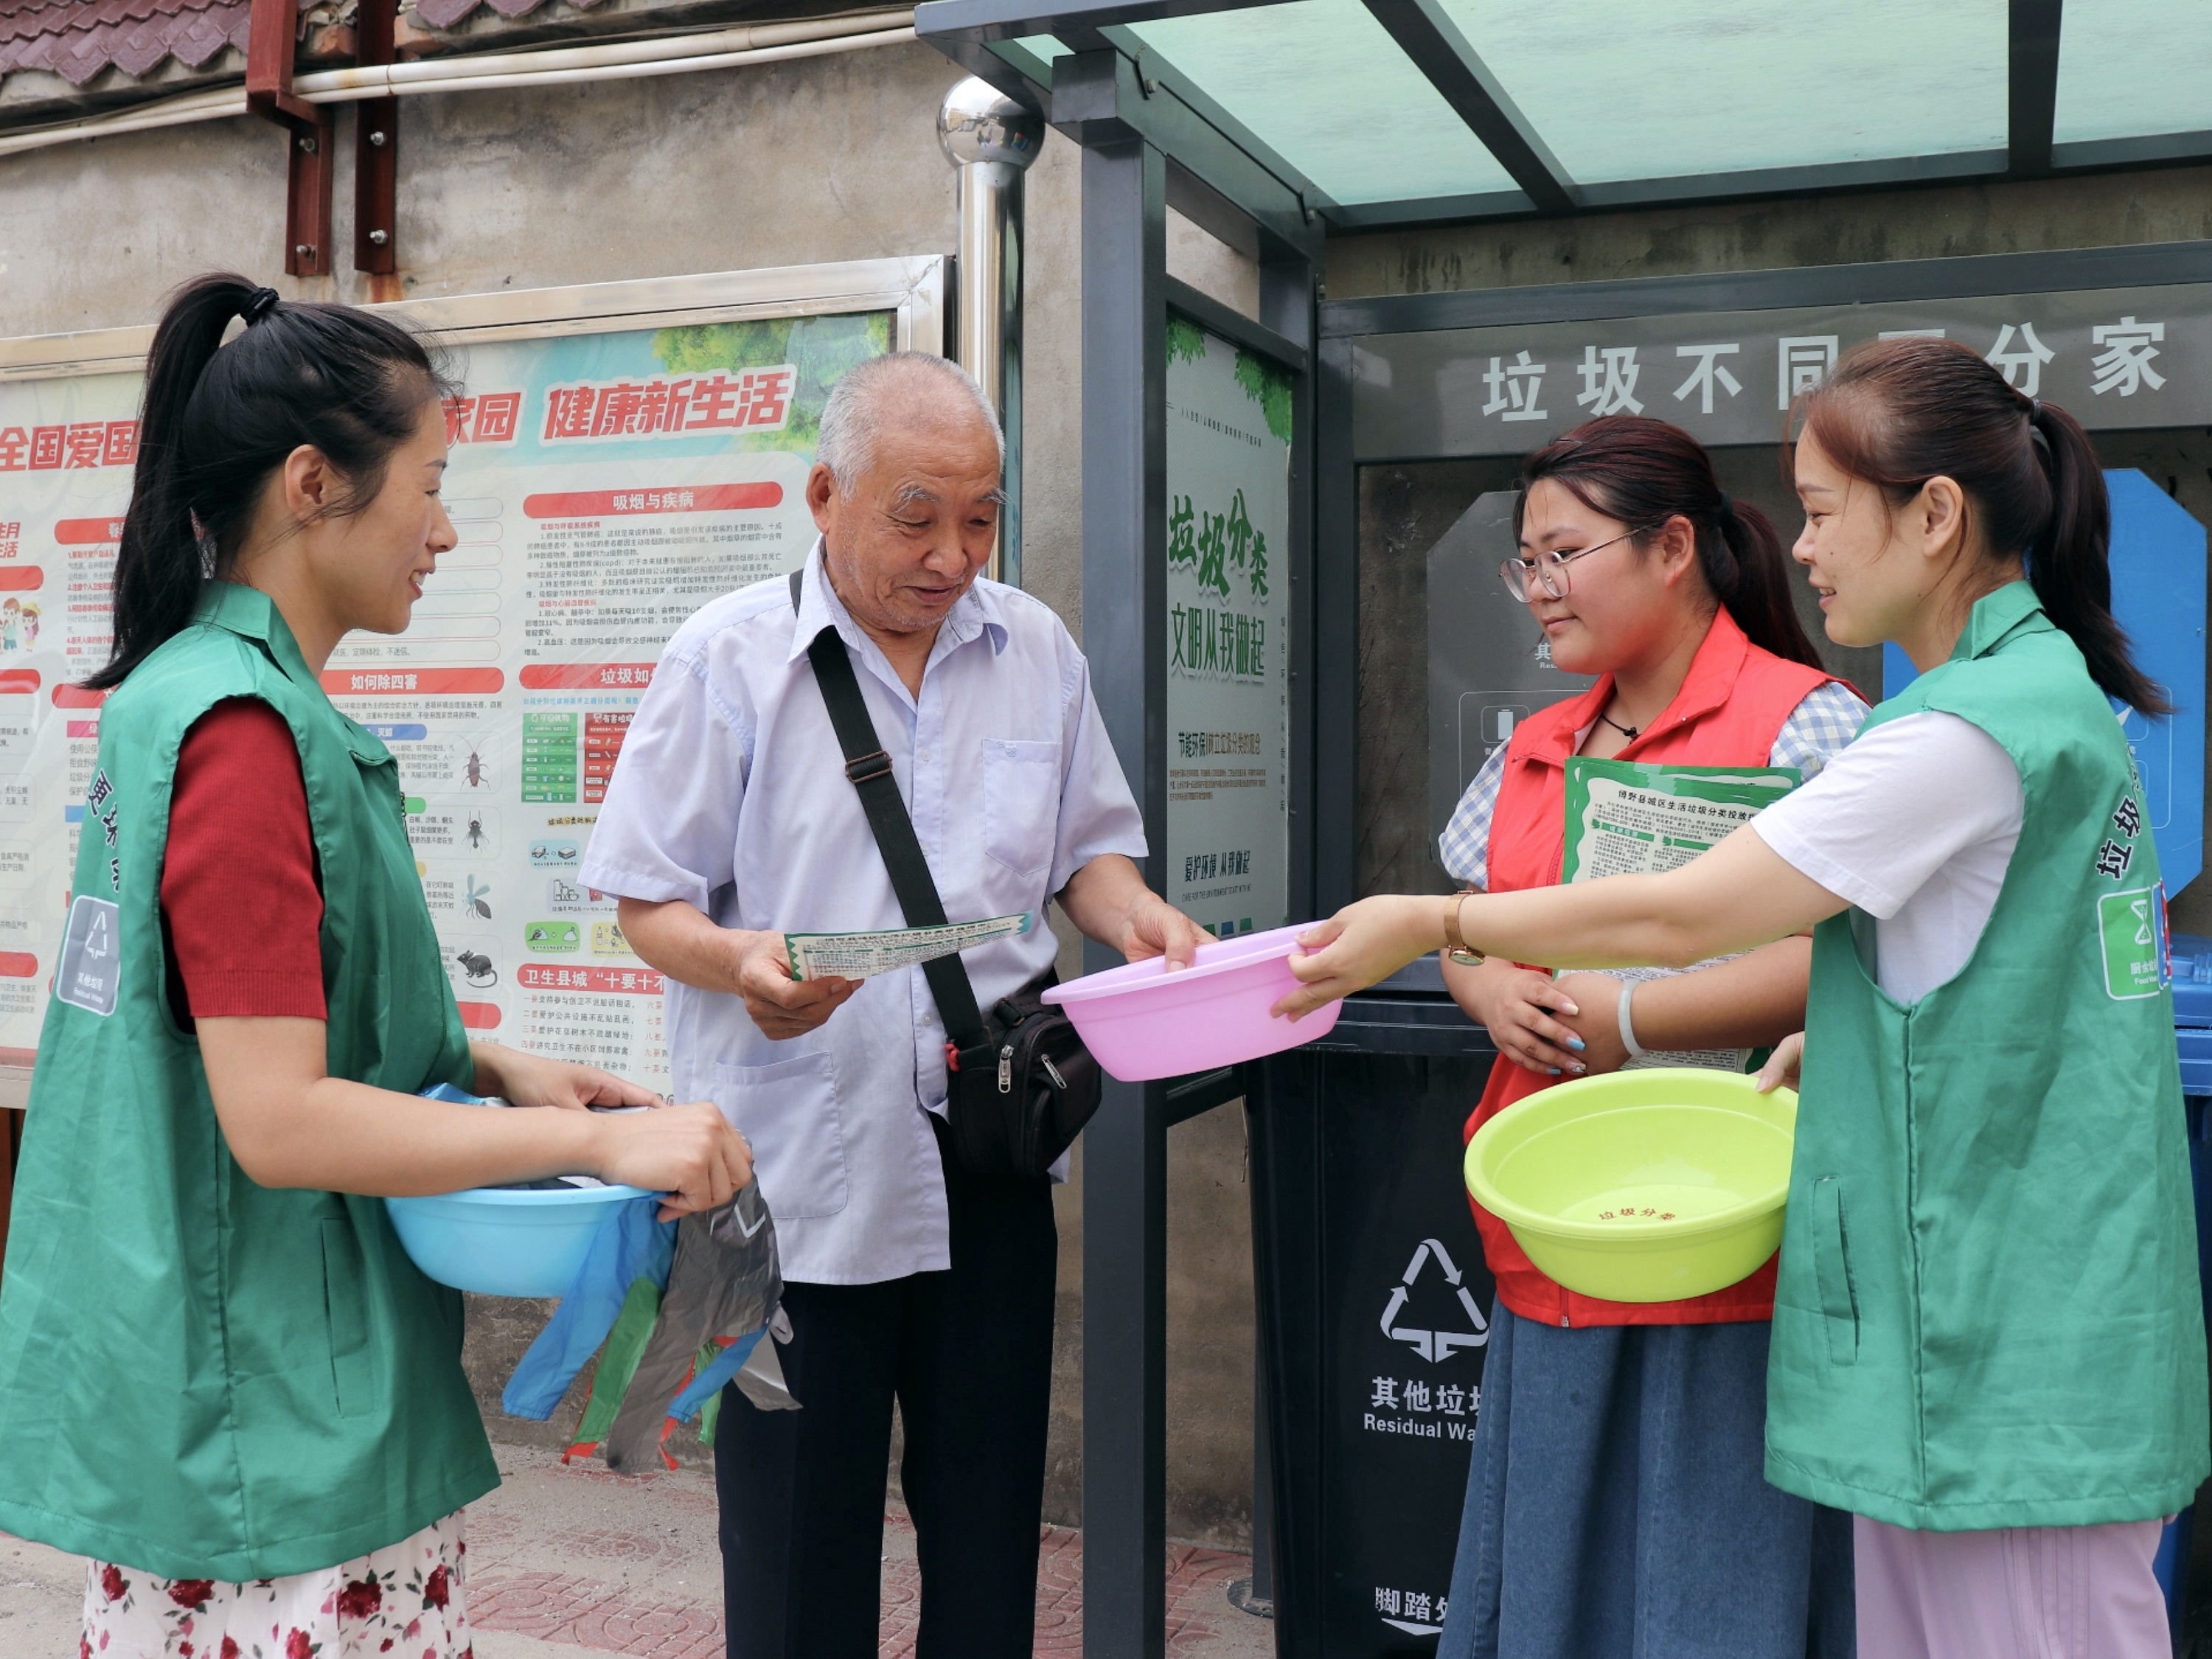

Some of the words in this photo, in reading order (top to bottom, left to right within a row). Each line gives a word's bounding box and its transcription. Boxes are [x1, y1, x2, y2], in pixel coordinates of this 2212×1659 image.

[1483, 316, 2166, 422] 垃圾不同分家
[544, 372, 791, 439] 健康新生活
[0, 420, 141, 471] 全国爱国
[613, 490, 694, 510] 吸烟与疾病
[541, 521, 600, 530] 吸烟与呼吸系统疾病
[0, 541, 18, 558] 活
[1169, 488, 1268, 598] 垃圾分类
[1172, 602, 1265, 676] 文明从我做起
[350, 674, 418, 690] 如何除四害
[540, 713, 570, 723] 可回收物
[69, 773, 92, 782] 垃圾分
[1185, 853, 1217, 882] 爱护环境
[1220, 850, 1251, 877] 从我做起
[1599, 1208, 1675, 1220] 垃圾分类
[1364, 1413, 1441, 1438] Residual
